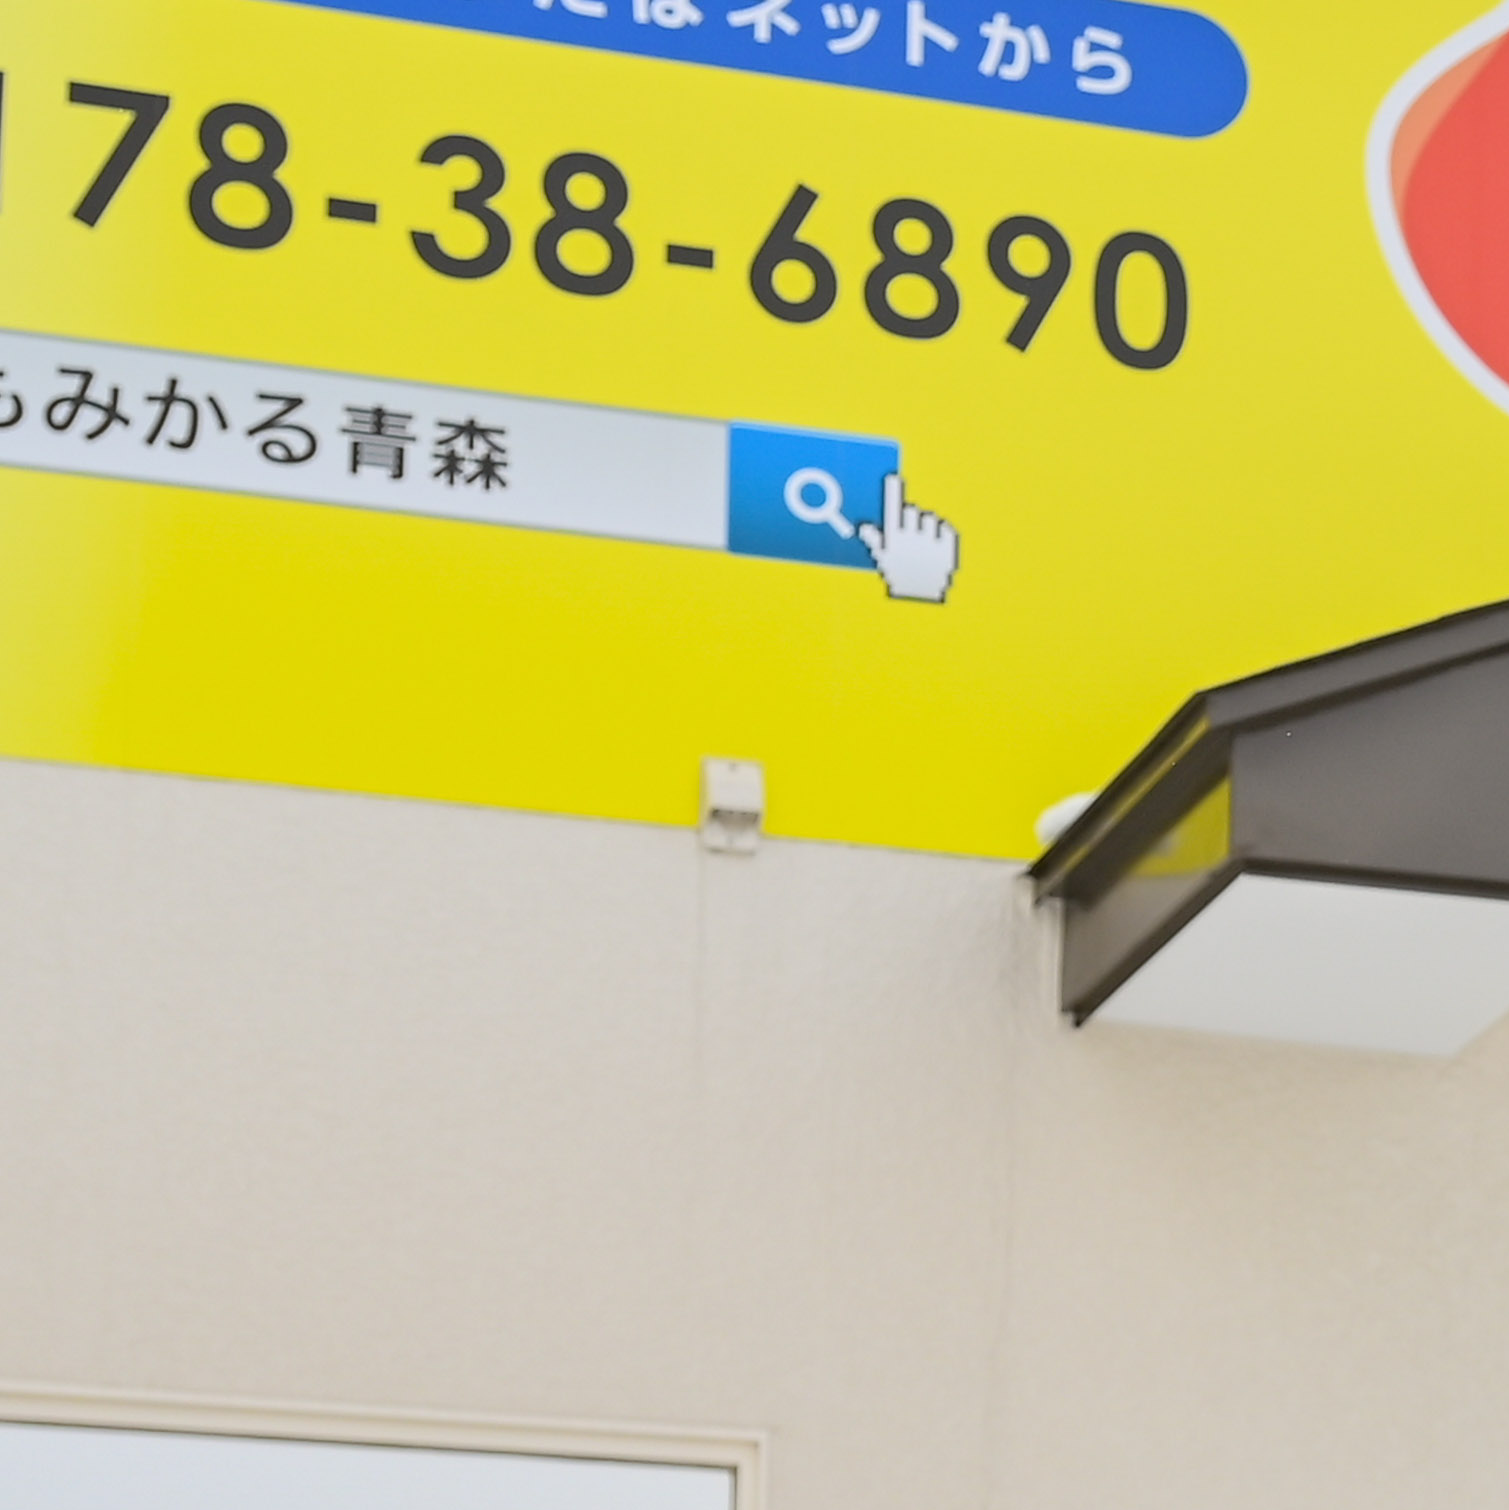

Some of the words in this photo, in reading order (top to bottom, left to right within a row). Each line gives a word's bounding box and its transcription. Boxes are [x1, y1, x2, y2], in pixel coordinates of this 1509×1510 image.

[533, 0, 1134, 96] ネットから
[0, 68, 1190, 371] 78-38-6890
